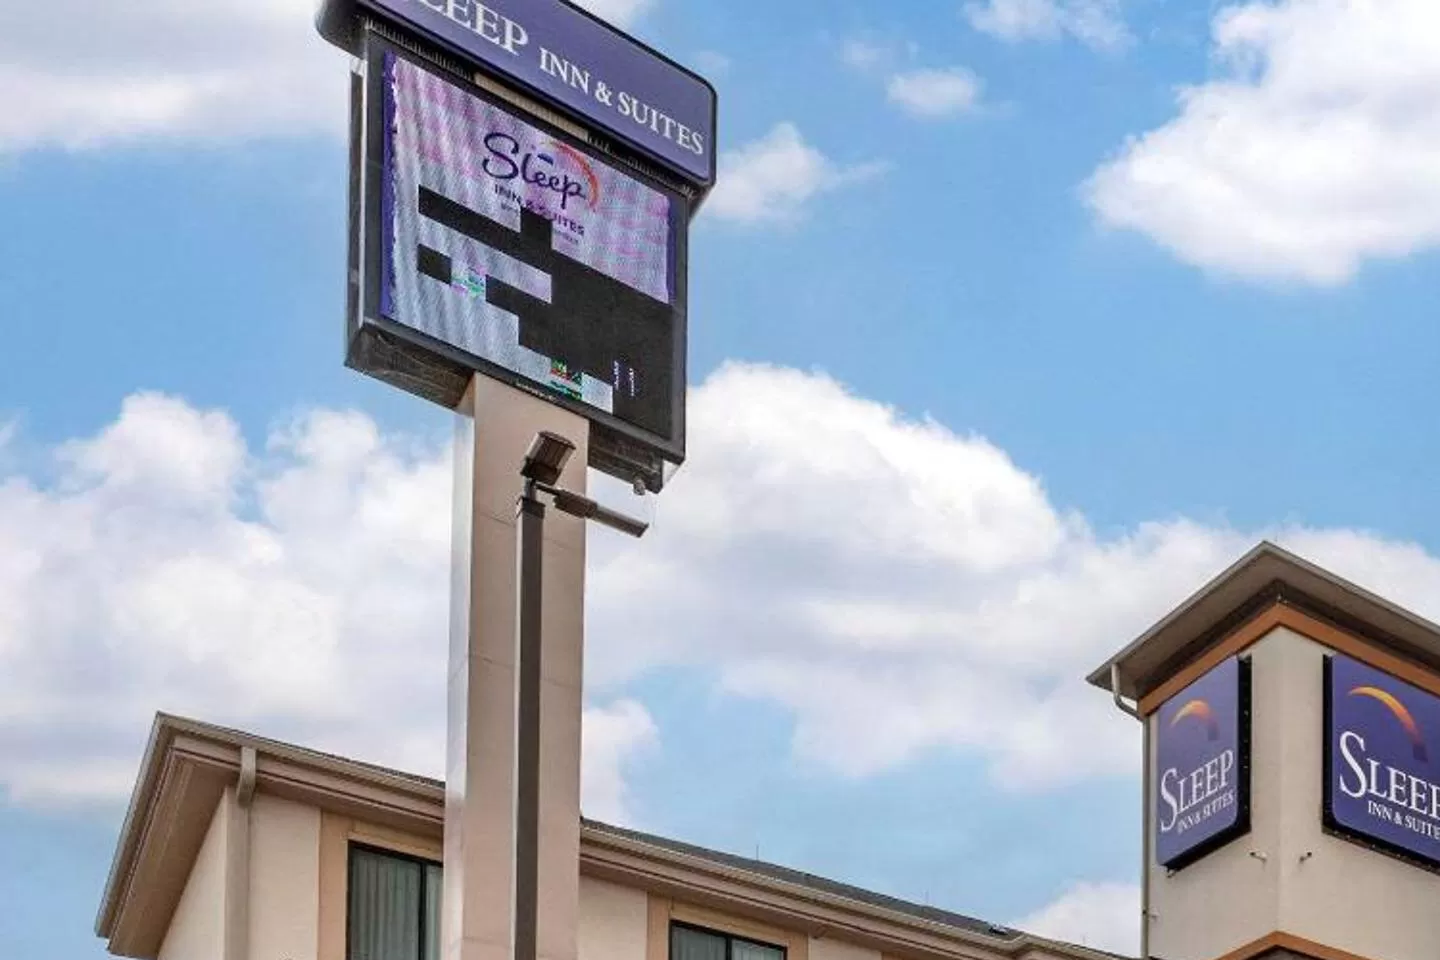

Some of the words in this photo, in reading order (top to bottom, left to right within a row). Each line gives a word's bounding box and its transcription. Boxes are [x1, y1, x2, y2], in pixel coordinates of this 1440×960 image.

[421, 0, 529, 56] EEP
[540, 47, 590, 95] INN
[595, 81, 612, 106] &
[617, 91, 704, 155] SUITES
[482, 133, 586, 209] Sleep
[1161, 750, 1234, 832] SLEEP
[1368, 800, 1393, 821] INN
[1394, 812, 1403, 825] &
